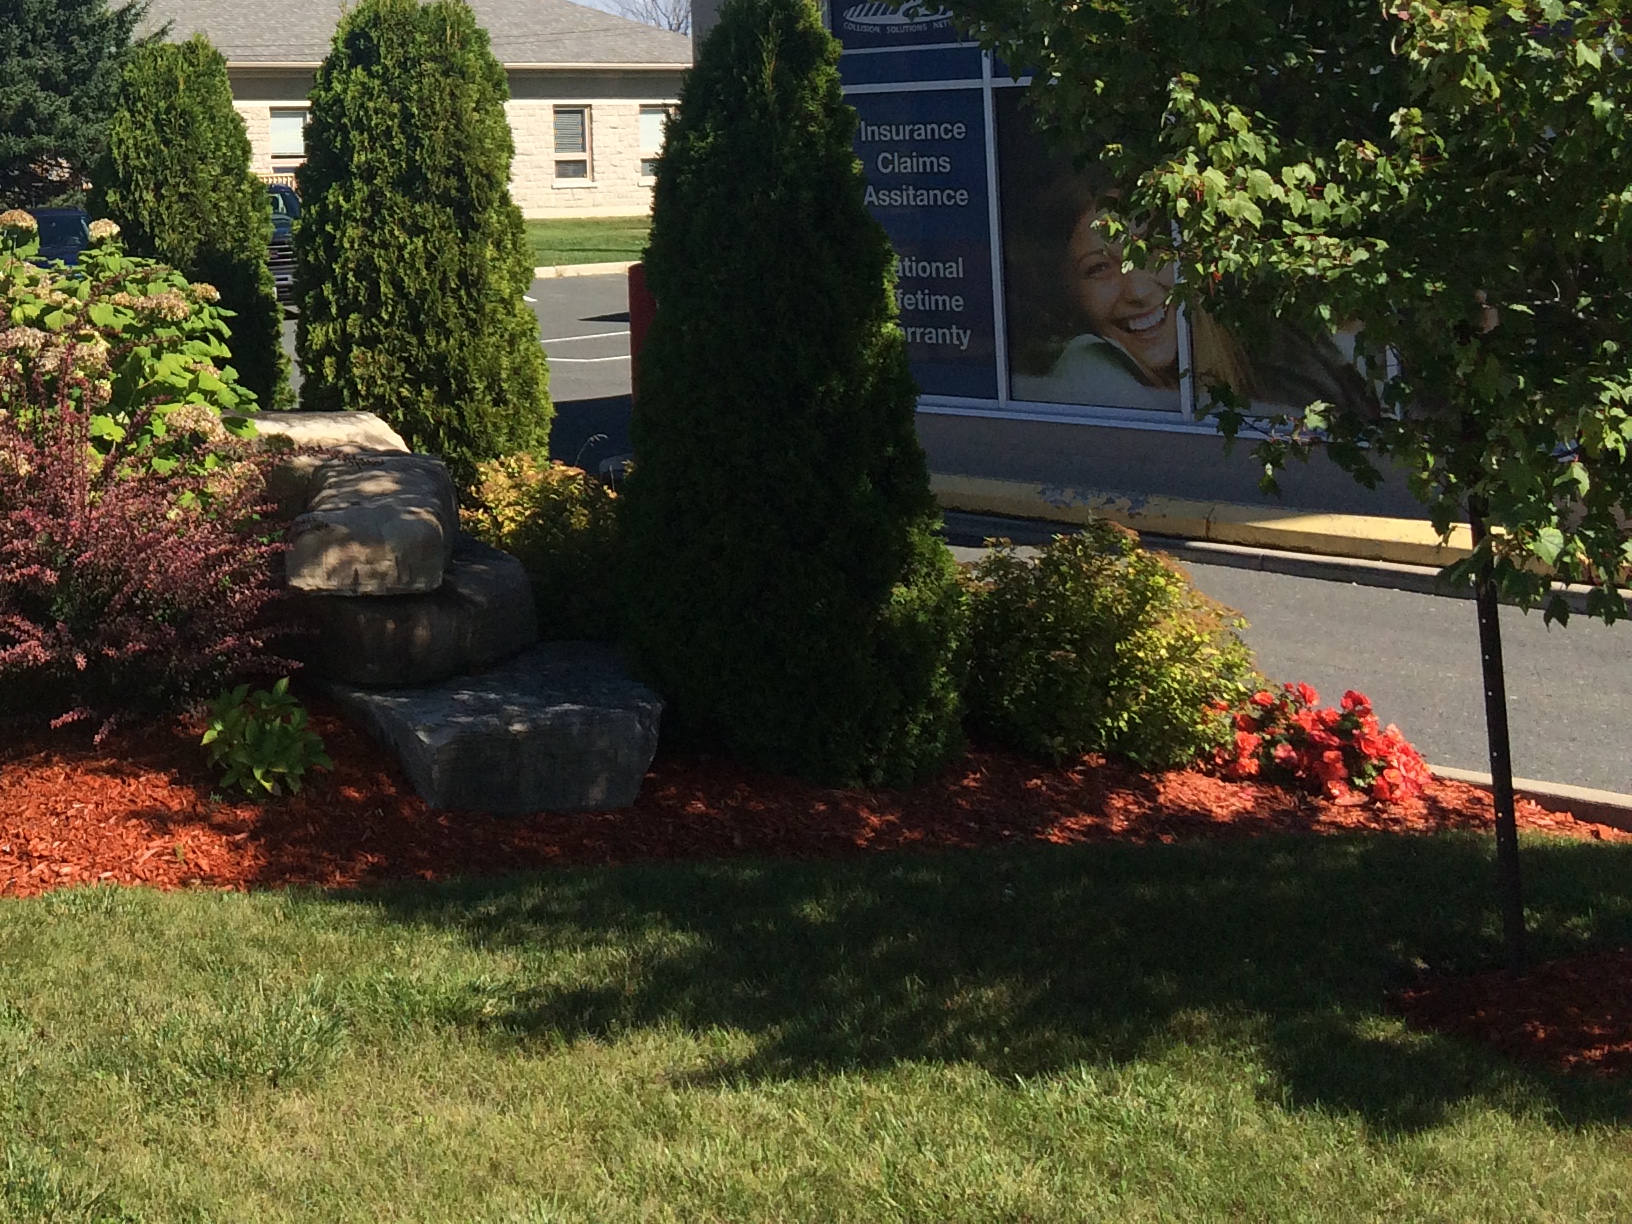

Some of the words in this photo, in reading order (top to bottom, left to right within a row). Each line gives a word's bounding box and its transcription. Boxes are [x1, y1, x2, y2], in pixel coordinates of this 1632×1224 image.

[843, 21, 880, 34] COLLISION
[886, 22, 928, 34] SOLUTIONS
[860, 121, 966, 141] Insurance
[877, 152, 951, 173] Claims
[863, 185, 969, 206] Assitance
[895, 256, 964, 278] ational
[895, 288, 965, 311] fetime
